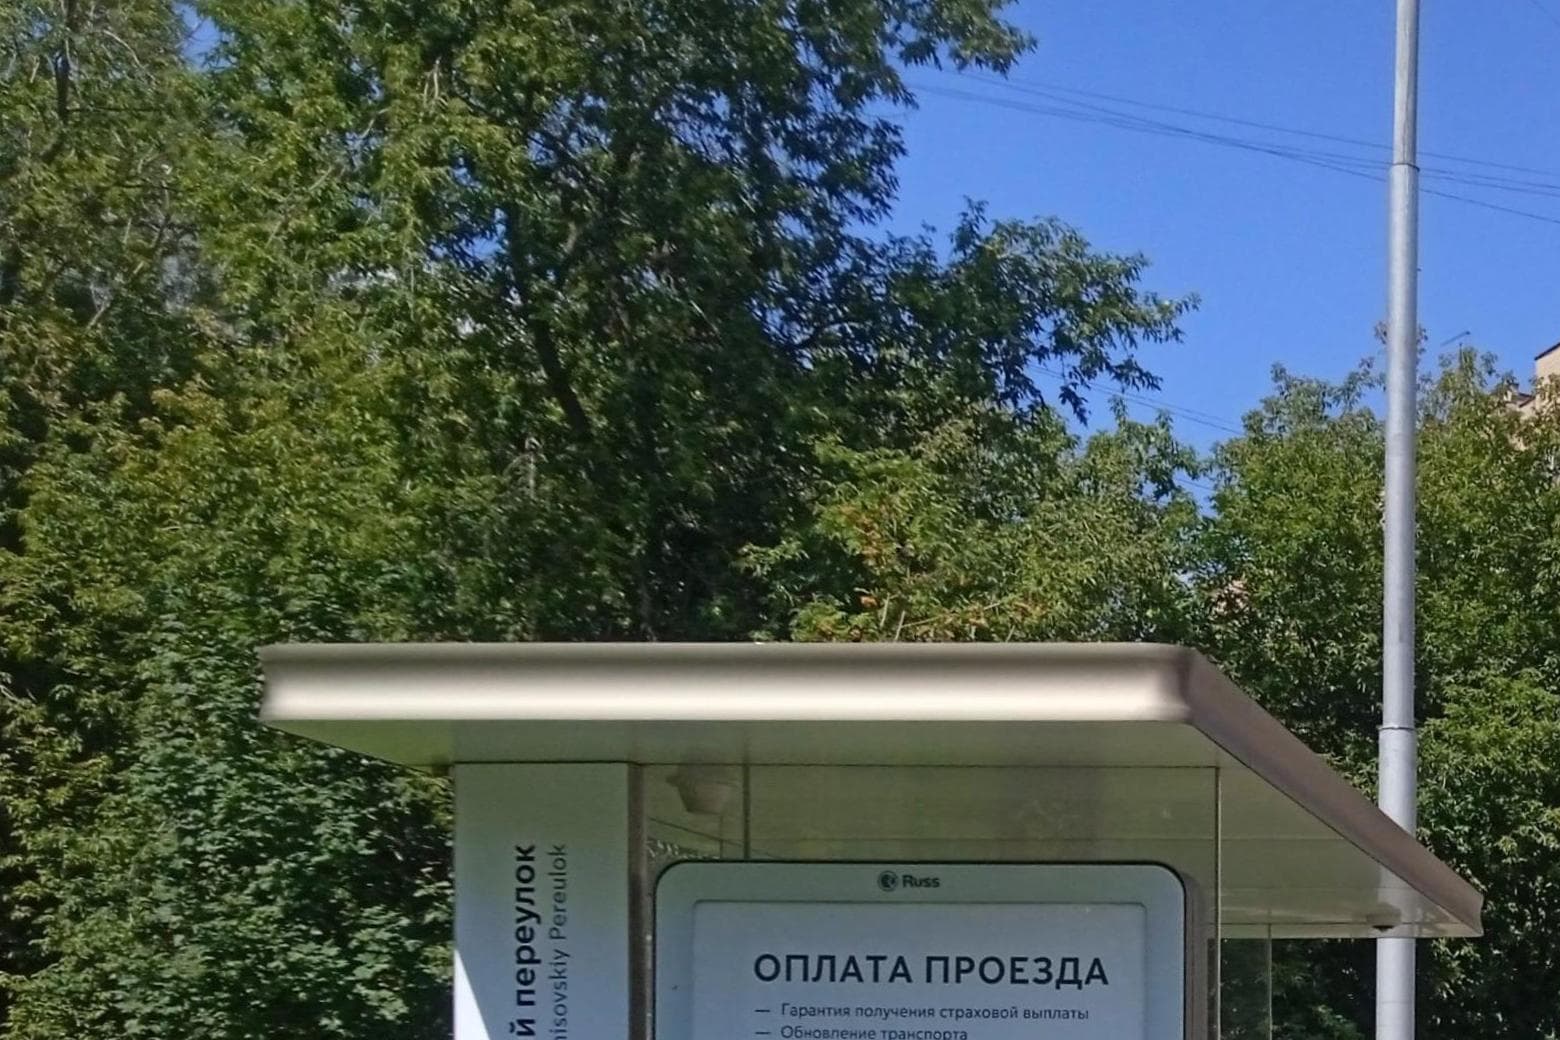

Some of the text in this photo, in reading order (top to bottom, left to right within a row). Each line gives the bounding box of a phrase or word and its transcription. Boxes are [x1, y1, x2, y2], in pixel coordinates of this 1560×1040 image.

[549, 843, 569, 940] Pereulok
[902, 875, 940, 888] Russ
[514, 844, 542, 1007] переулок
[754, 953, 1110, 990] ОПЛАТА ПРОЕЗДА
[780, 1003, 1089, 1022] Гарантия получения страховой выплаты
[780, 1024, 876, 1040] Обновление
